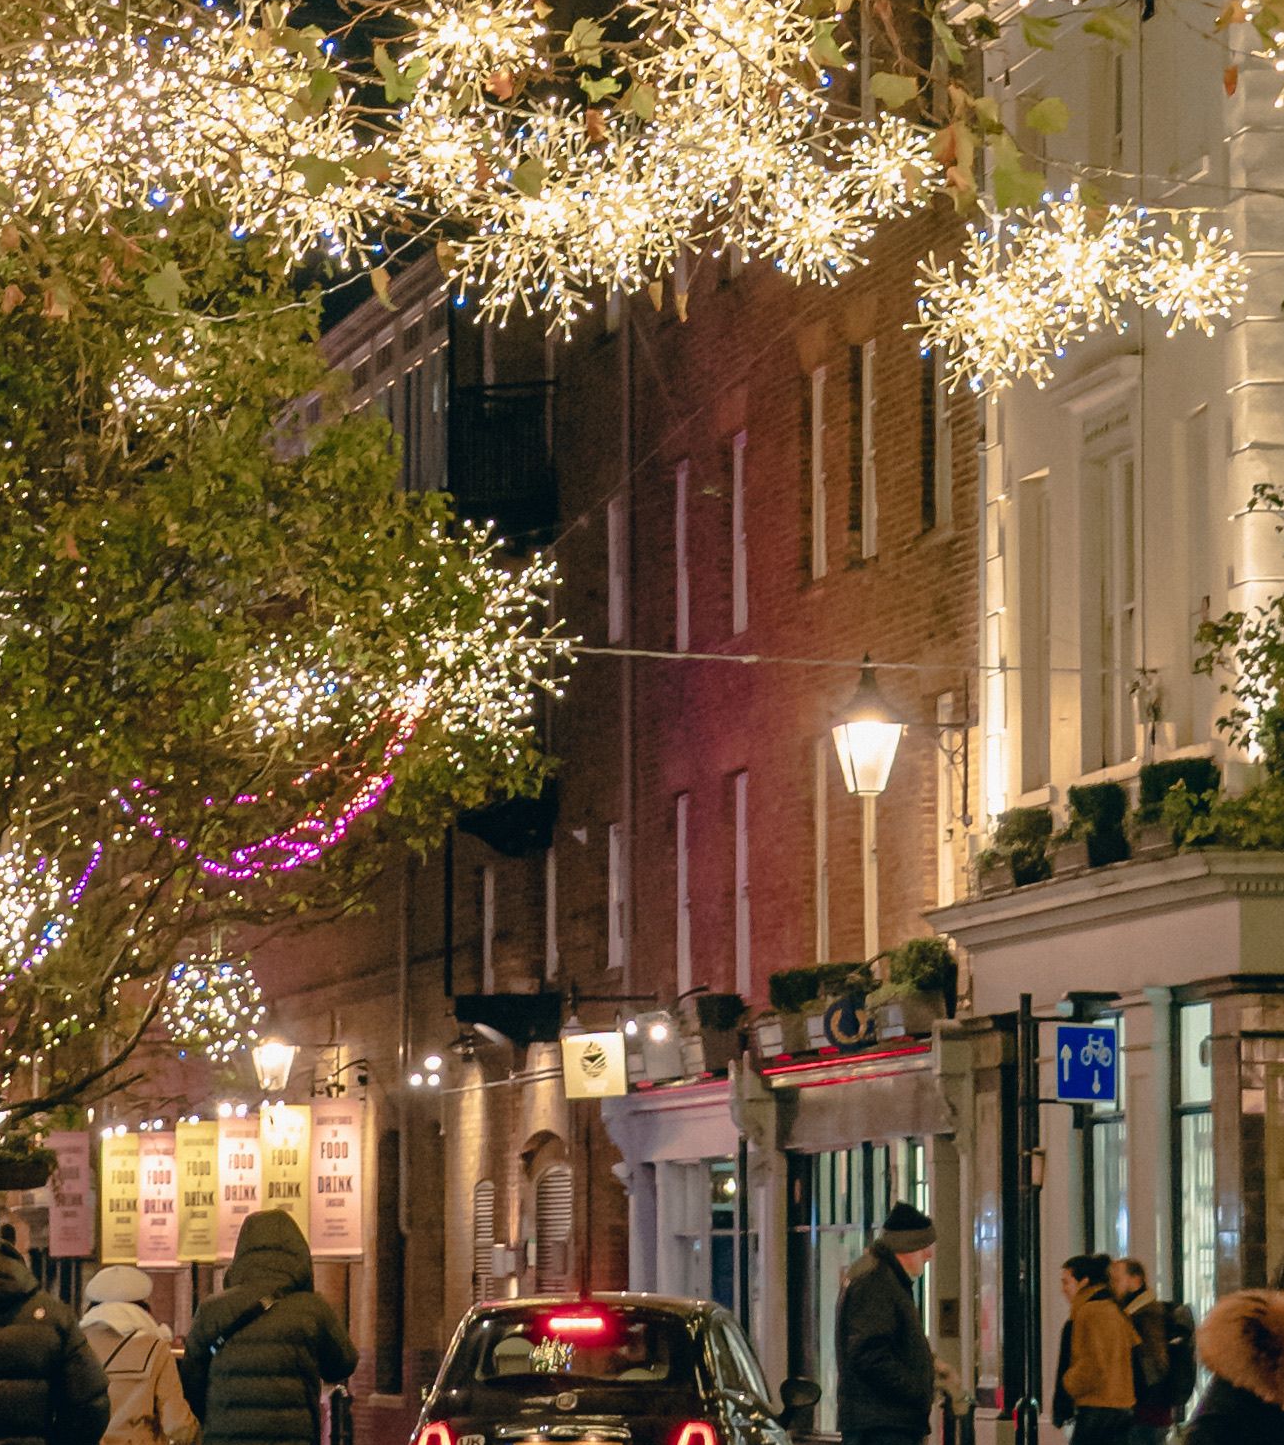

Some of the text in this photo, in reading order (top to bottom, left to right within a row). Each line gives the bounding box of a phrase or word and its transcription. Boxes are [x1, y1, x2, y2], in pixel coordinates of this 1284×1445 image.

[271, 1149, 298, 1166] FOOD
[320, 1142, 349, 1159] FOOD
[187, 1161, 211, 1176] FOOD
[228, 1154, 254, 1169] FOOD
[111, 1170, 135, 1185] FOOD
[147, 1170, 172, 1185] FOOD
[318, 1176, 353, 1194] DRINK
[225, 1185, 257, 1201] DRINK
[268, 1182, 301, 1198] DRINK
[109, 1198, 138, 1213] DRINK
[144, 1198, 174, 1214] DRINK
[184, 1191, 215, 1207] DRINK
